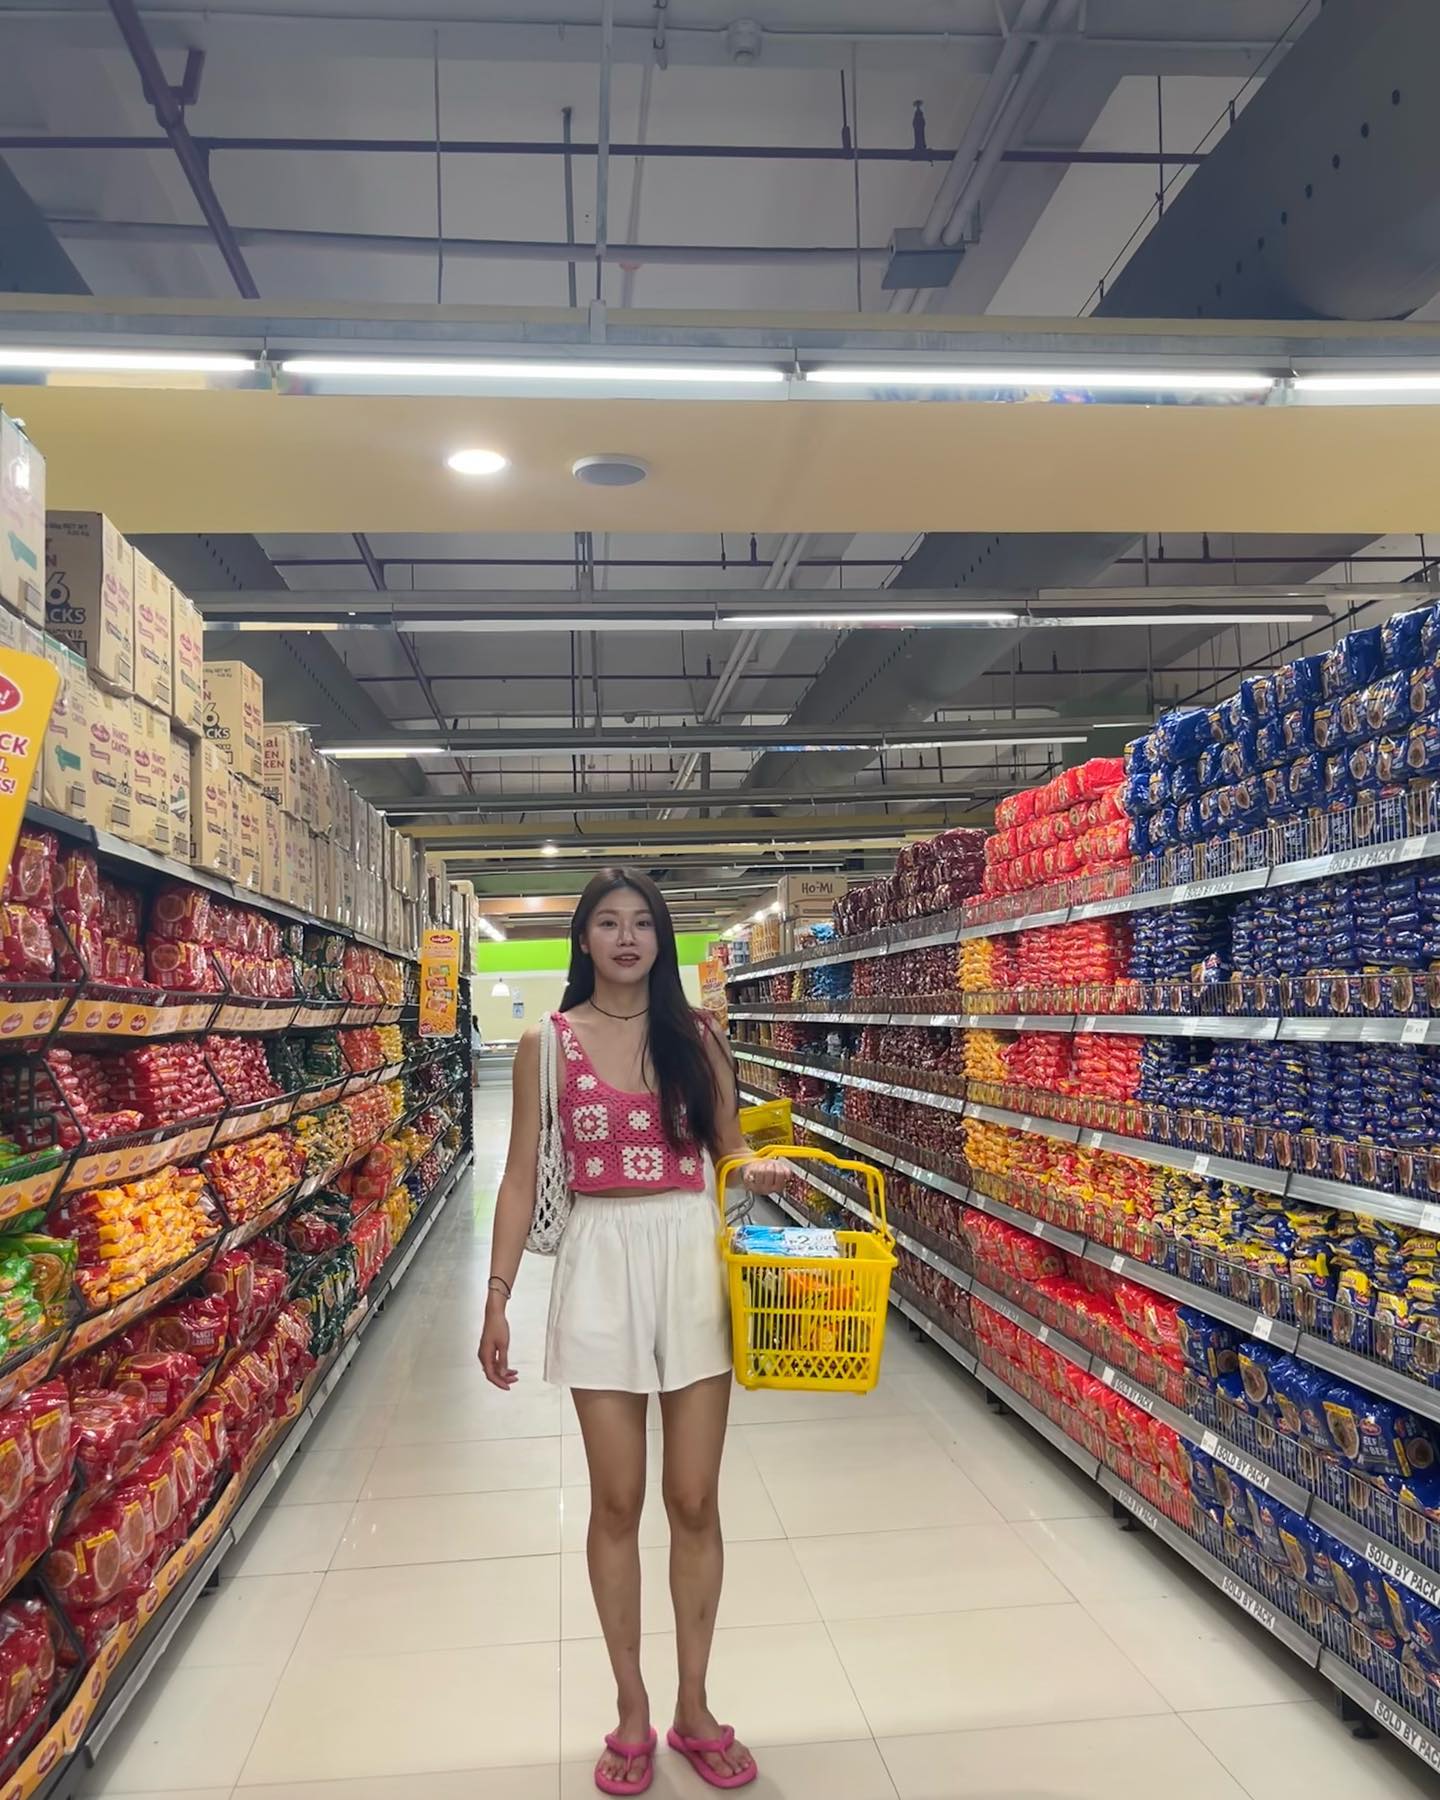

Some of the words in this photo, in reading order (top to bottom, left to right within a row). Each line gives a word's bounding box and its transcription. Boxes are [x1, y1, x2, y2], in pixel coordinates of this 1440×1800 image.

[46, 571, 70, 605] 6
[48, 606, 86, 623] CKS
[203, 702, 220, 727] 6
[205, 728, 230, 739] CKS
[1218, 1447, 1236, 1466] SOLD
[1247, 1466, 1268, 1488] PACK
[1368, 1544, 1394, 1571] SOLD
[1394, 1562, 1410, 1581] BY
[1410, 1573, 1439, 1602] PACK
[1224, 1578, 1243, 1600] SOLD
[1253, 1601, 1273, 1627] PACK
[1376, 1701, 1402, 1732] SOLD
[1403, 1726, 1418, 1746] BY
